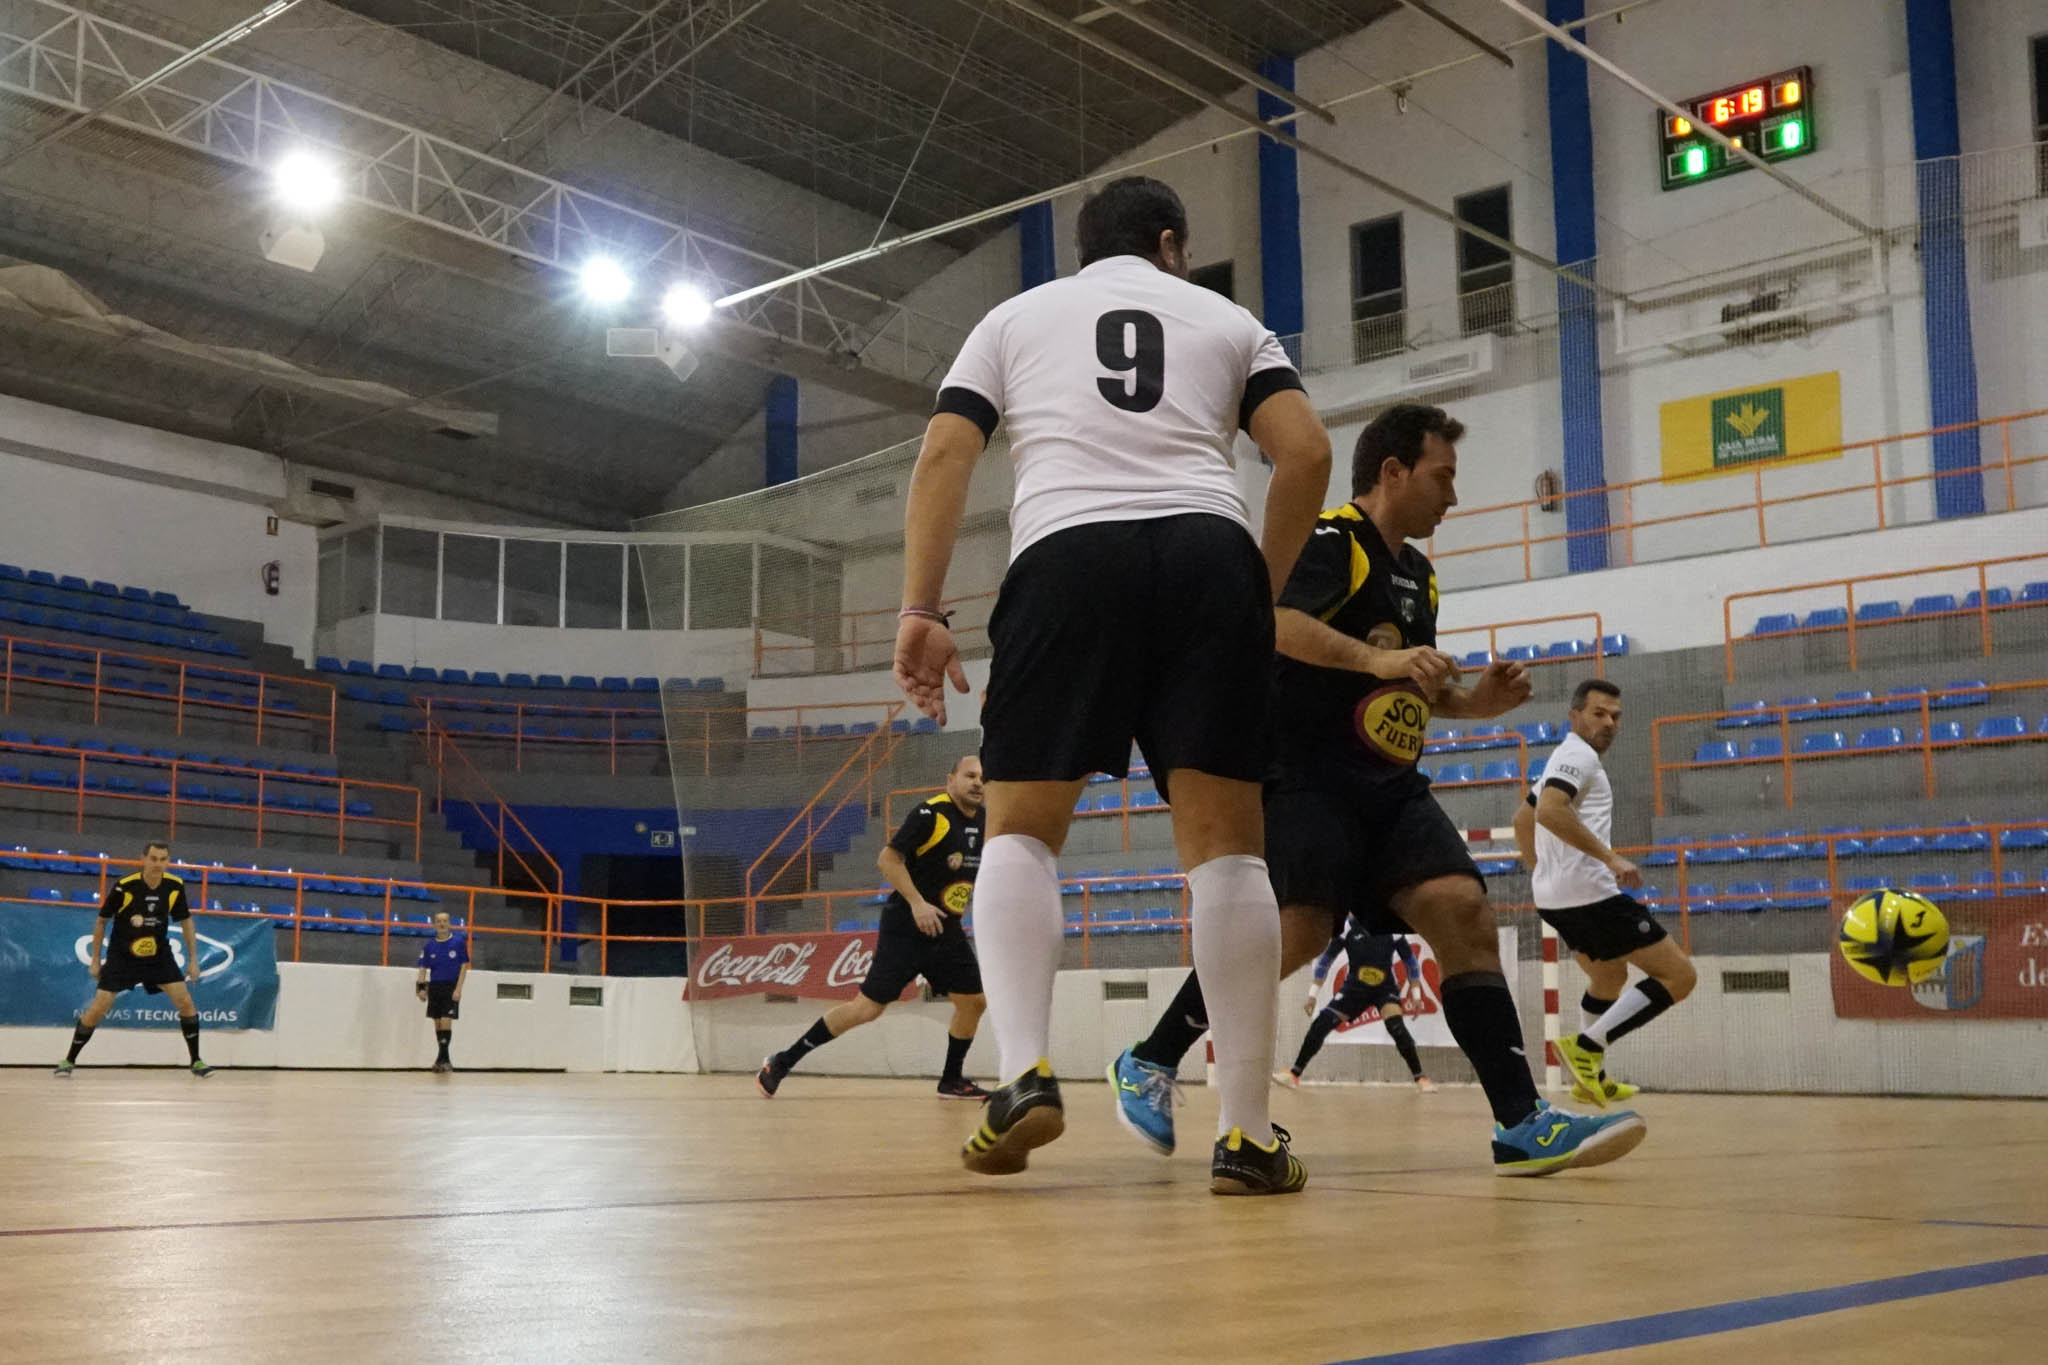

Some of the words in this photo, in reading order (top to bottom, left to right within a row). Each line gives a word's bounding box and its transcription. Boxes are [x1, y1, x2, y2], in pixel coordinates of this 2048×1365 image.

[1714, 88, 1763, 123] 6:19
[1096, 309, 1165, 413] 9
[1374, 719, 1420, 753] FUER
